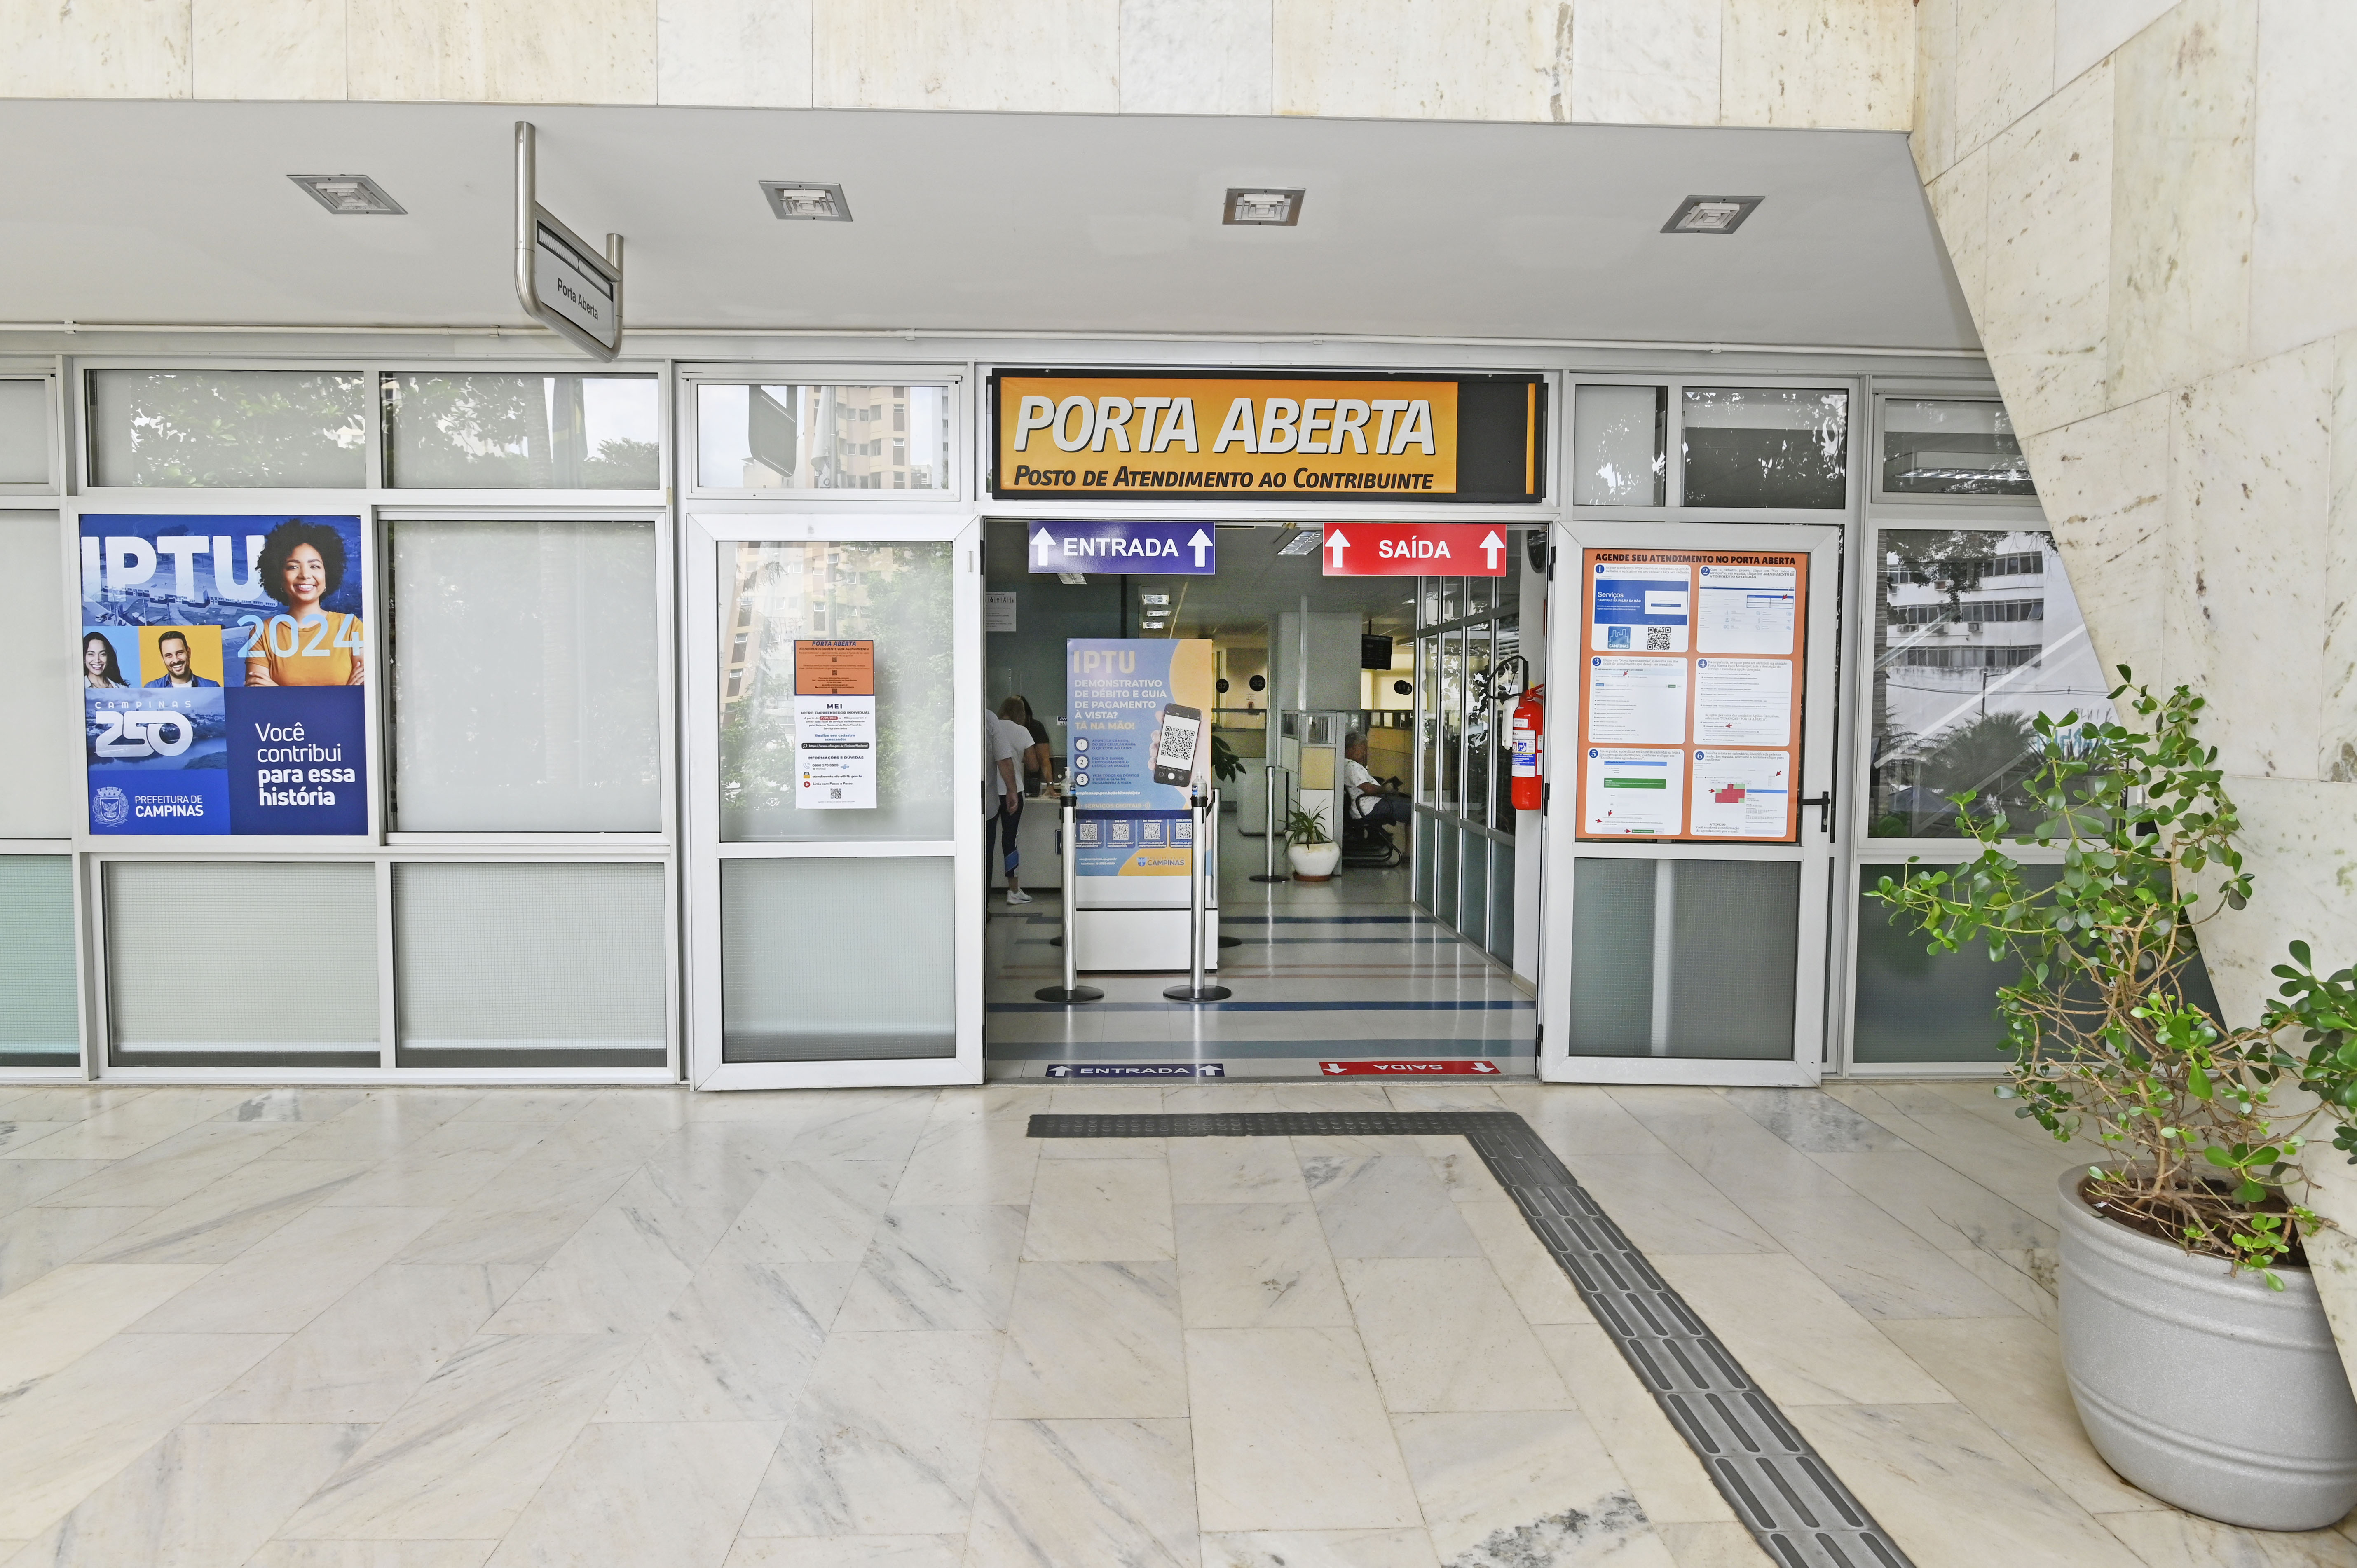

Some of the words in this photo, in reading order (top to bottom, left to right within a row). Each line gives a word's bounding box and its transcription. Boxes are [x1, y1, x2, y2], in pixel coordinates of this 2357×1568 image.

[558, 277, 576, 304] Porta
[578, 294, 598, 320] Aberta
[1014, 395, 1199, 453] PORTA
[1212, 397, 1436, 456] ABERTA
[1063, 538, 1179, 557] ENTRADA
[1378, 535, 1451, 559] SAÍDA
[81, 535, 265, 603] IPTU
[1650, 555, 1713, 563] ATENDIMENTO
[236, 613, 364, 658] 2024
[1073, 650, 1136, 674] IPTU
[1092, 689, 1129, 697] DÉBITO
[1141, 690, 1167, 698] GUIA
[95, 700, 191, 709] CAMPINAS
[1075, 709, 1082, 719] À
[95, 710, 193, 757] 250
[255, 722, 305, 742] Você
[1075, 720, 1087, 730] TÁ
[1108, 720, 1134, 730] MÃO!
[257, 743, 342, 763] contribui
[258, 769, 303, 786] para
[308, 768, 355, 783] essa
[135, 795, 189, 804] PREFEITURA
[191, 795, 203, 803] DE
[259, 786, 335, 806] história
[136, 805, 204, 817] CAMPINAS
